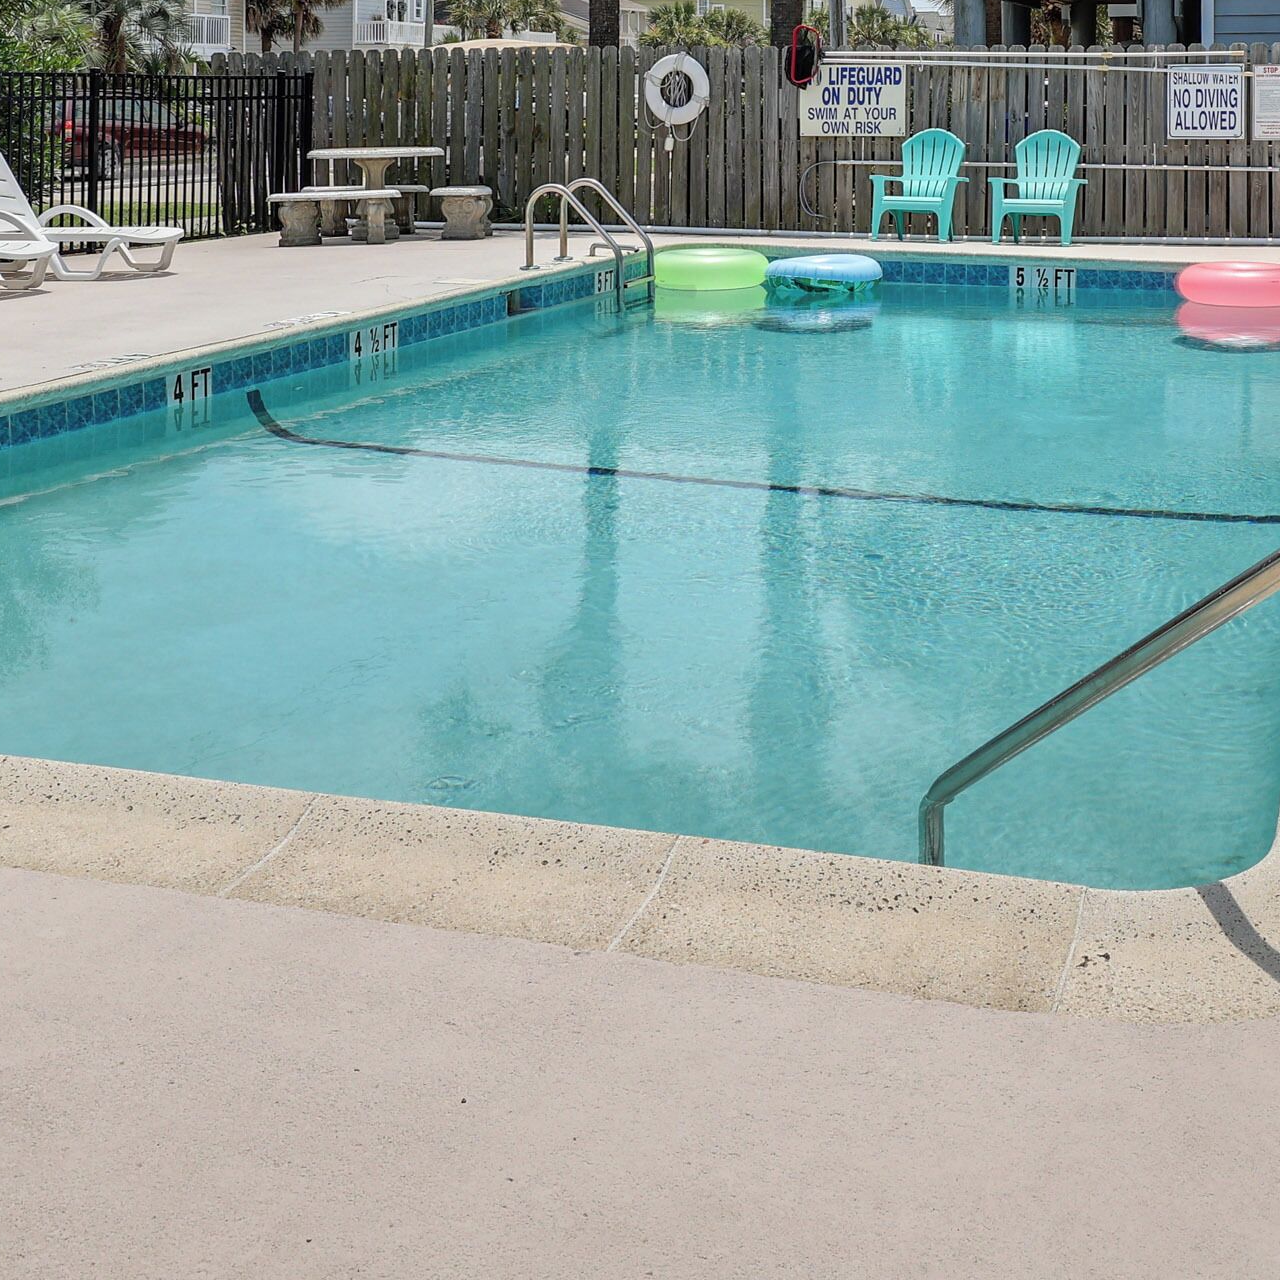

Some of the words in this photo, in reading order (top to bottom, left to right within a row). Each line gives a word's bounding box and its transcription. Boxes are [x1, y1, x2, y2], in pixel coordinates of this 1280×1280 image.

[829, 67, 902, 85] LIFEGUARD
[1173, 72, 1209, 85] SHALLOW
[1213, 73, 1239, 85] WATER
[1263, 66, 1278, 74] STOP
[822, 87, 840, 106] ON
[847, 87, 882, 106] DUTY
[1173, 88, 1191, 108] NO
[1195, 88, 1238, 108] DIVING
[808, 107, 838, 120] SWIM
[843, 107, 859, 120] AT
[864, 107, 897, 120] YOUR
[1174, 110, 1237, 130] ALLOWED
[821, 121, 849, 134] OWN
[855, 121, 882, 134] RISK
[597, 272, 603, 293] 5
[604, 270, 614, 292] FT
[1016, 267, 1025, 287] 5
[1055, 269, 1075, 288] FT
[353, 331, 363, 357] 4
[383, 322, 398, 350] FT
[173, 374, 184, 404] 4
[191, 368, 211, 401] FT
